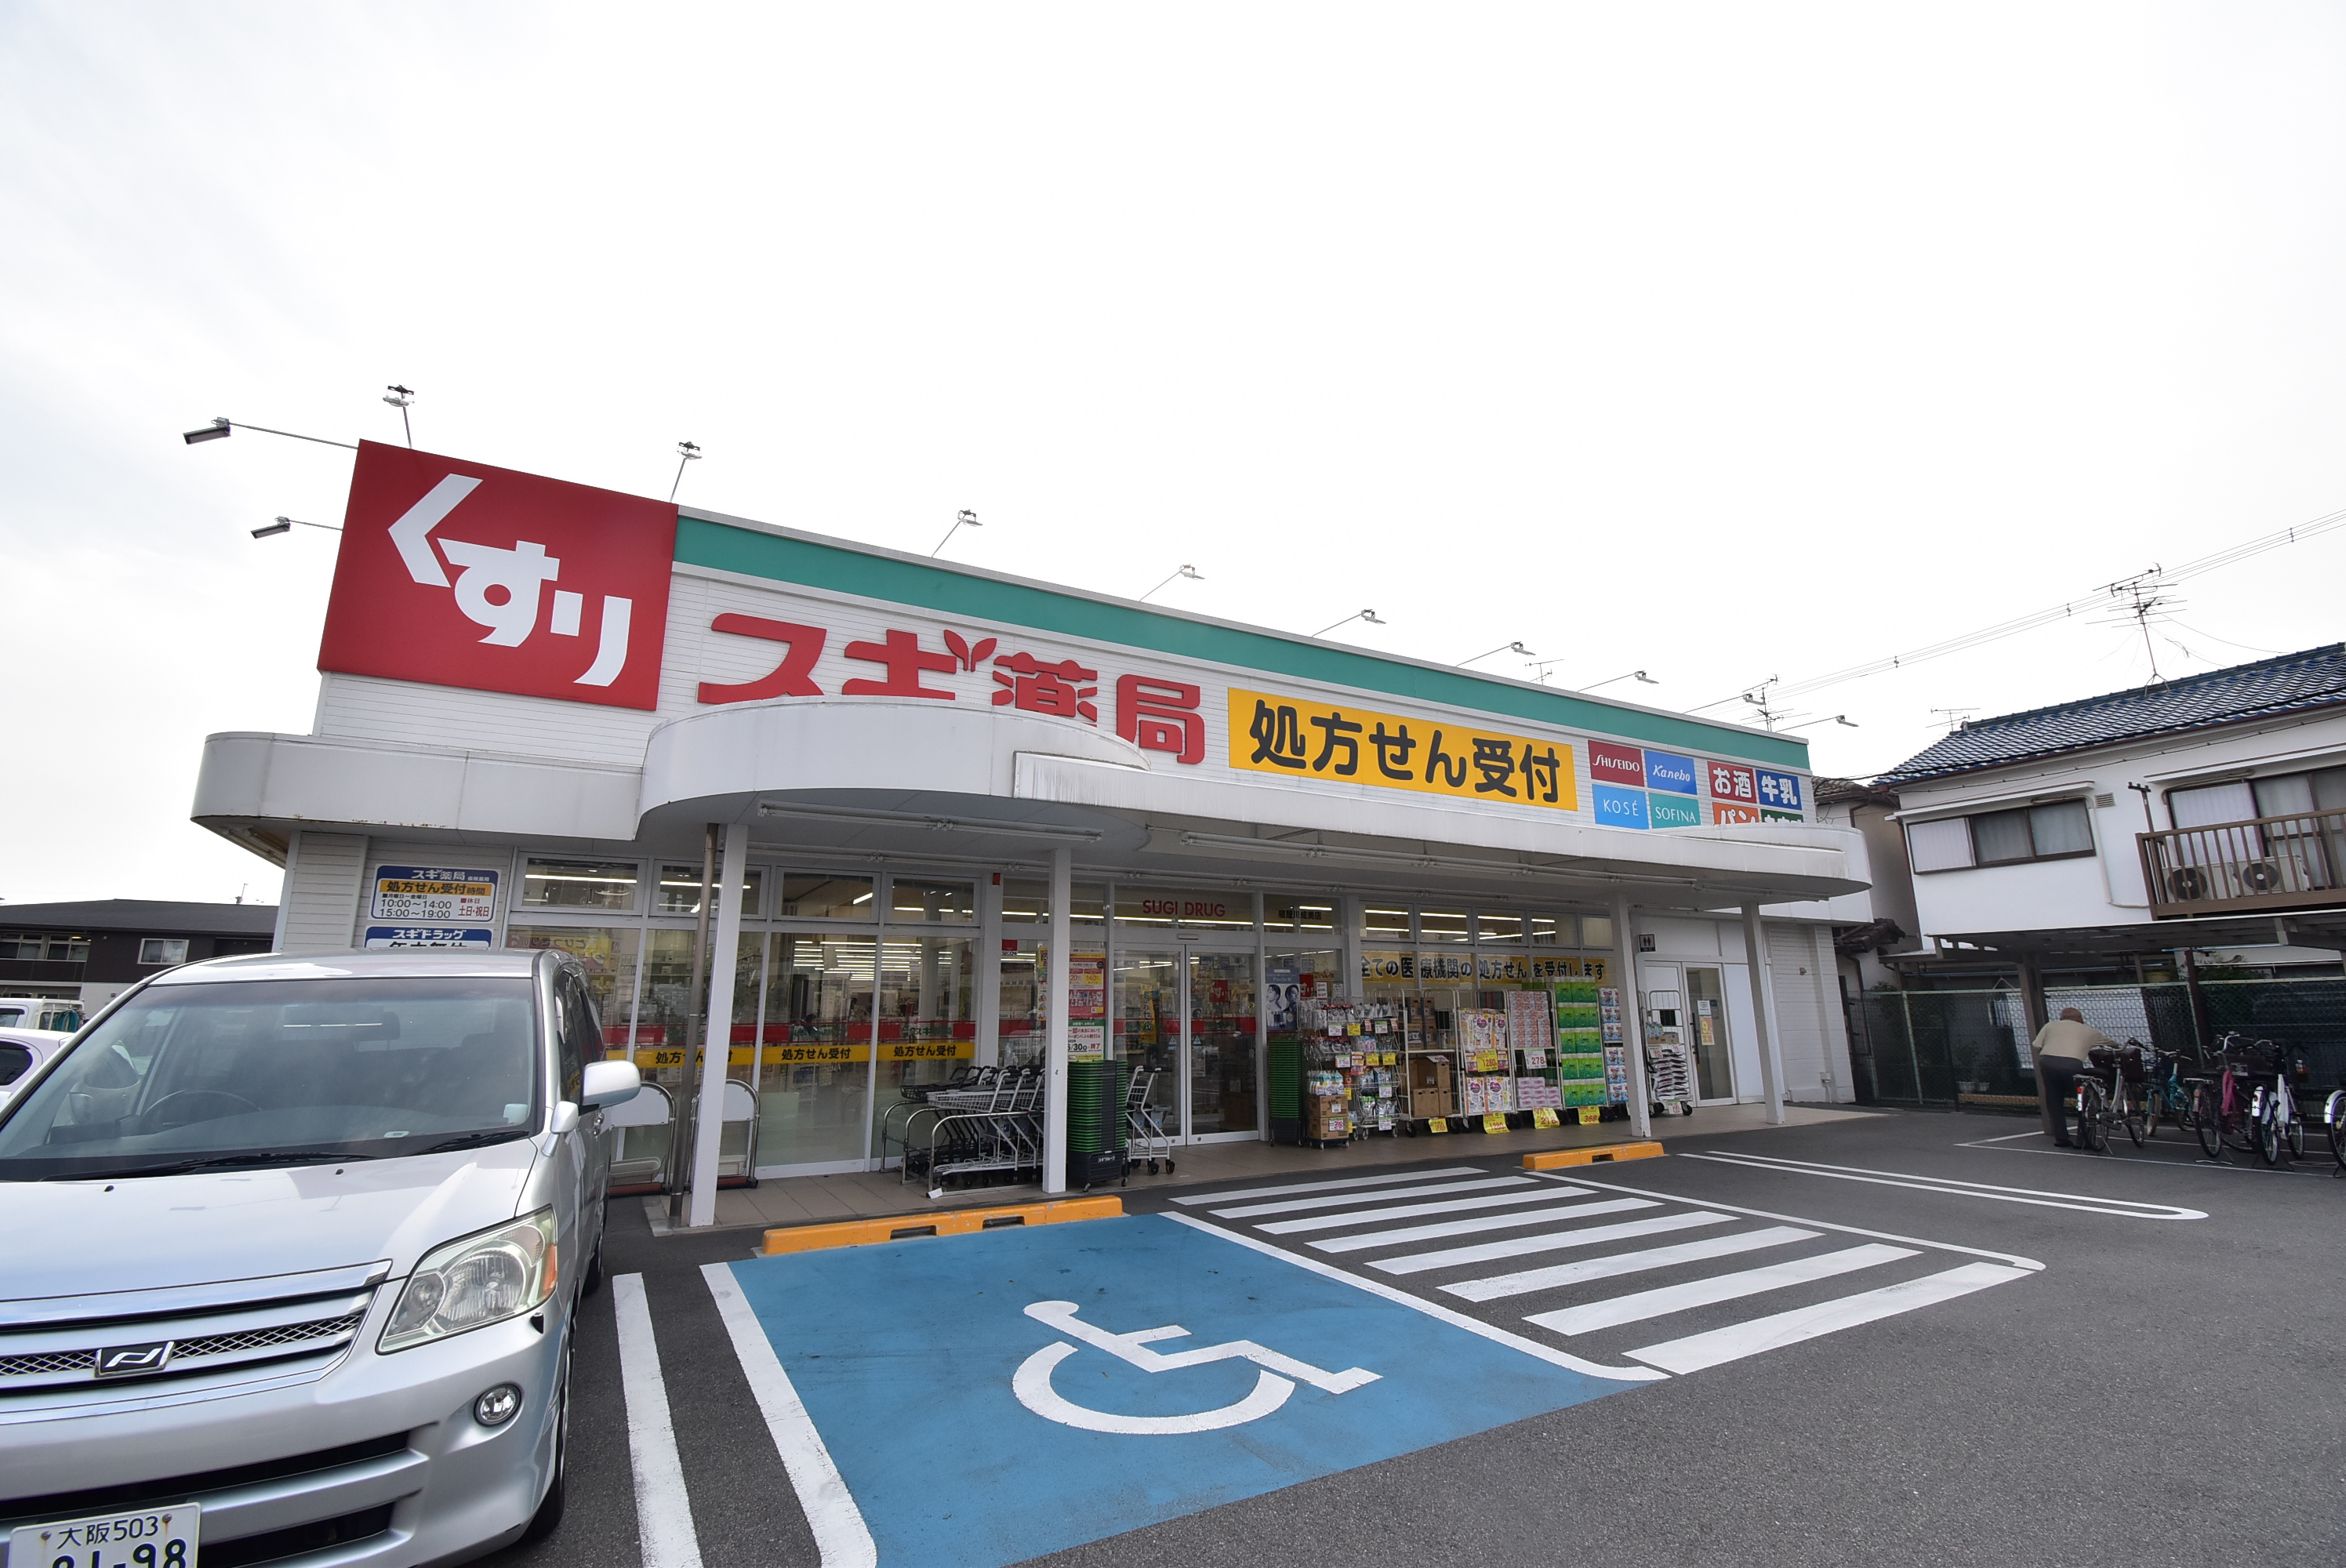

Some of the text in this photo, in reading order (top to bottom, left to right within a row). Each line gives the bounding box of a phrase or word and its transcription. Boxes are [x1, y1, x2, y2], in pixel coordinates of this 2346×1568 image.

[388, 473, 632, 687] くすり
[697, 612, 1205, 764] スギ薬局
[1249, 699, 1560, 803] 処方せん受付
[1592, 754, 1640, 772] SHISEIDO
[1652, 764, 1690, 782] Kanebo
[1712, 767, 1752, 798] お酒
[1761, 775, 1798, 805] 牛乳
[1603, 798, 1640, 817] KOSÉ
[1654, 806, 1697, 823] SOFINA
[411, 869, 466, 880] スギ薬局
[1142, 899, 1226, 917] SUGI DRUG
[393, 929, 467, 940] スギドラッグ
[781, 1047, 852, 1061] 処方せん受付
[894, 1045, 957, 1057] 処方せん受付
